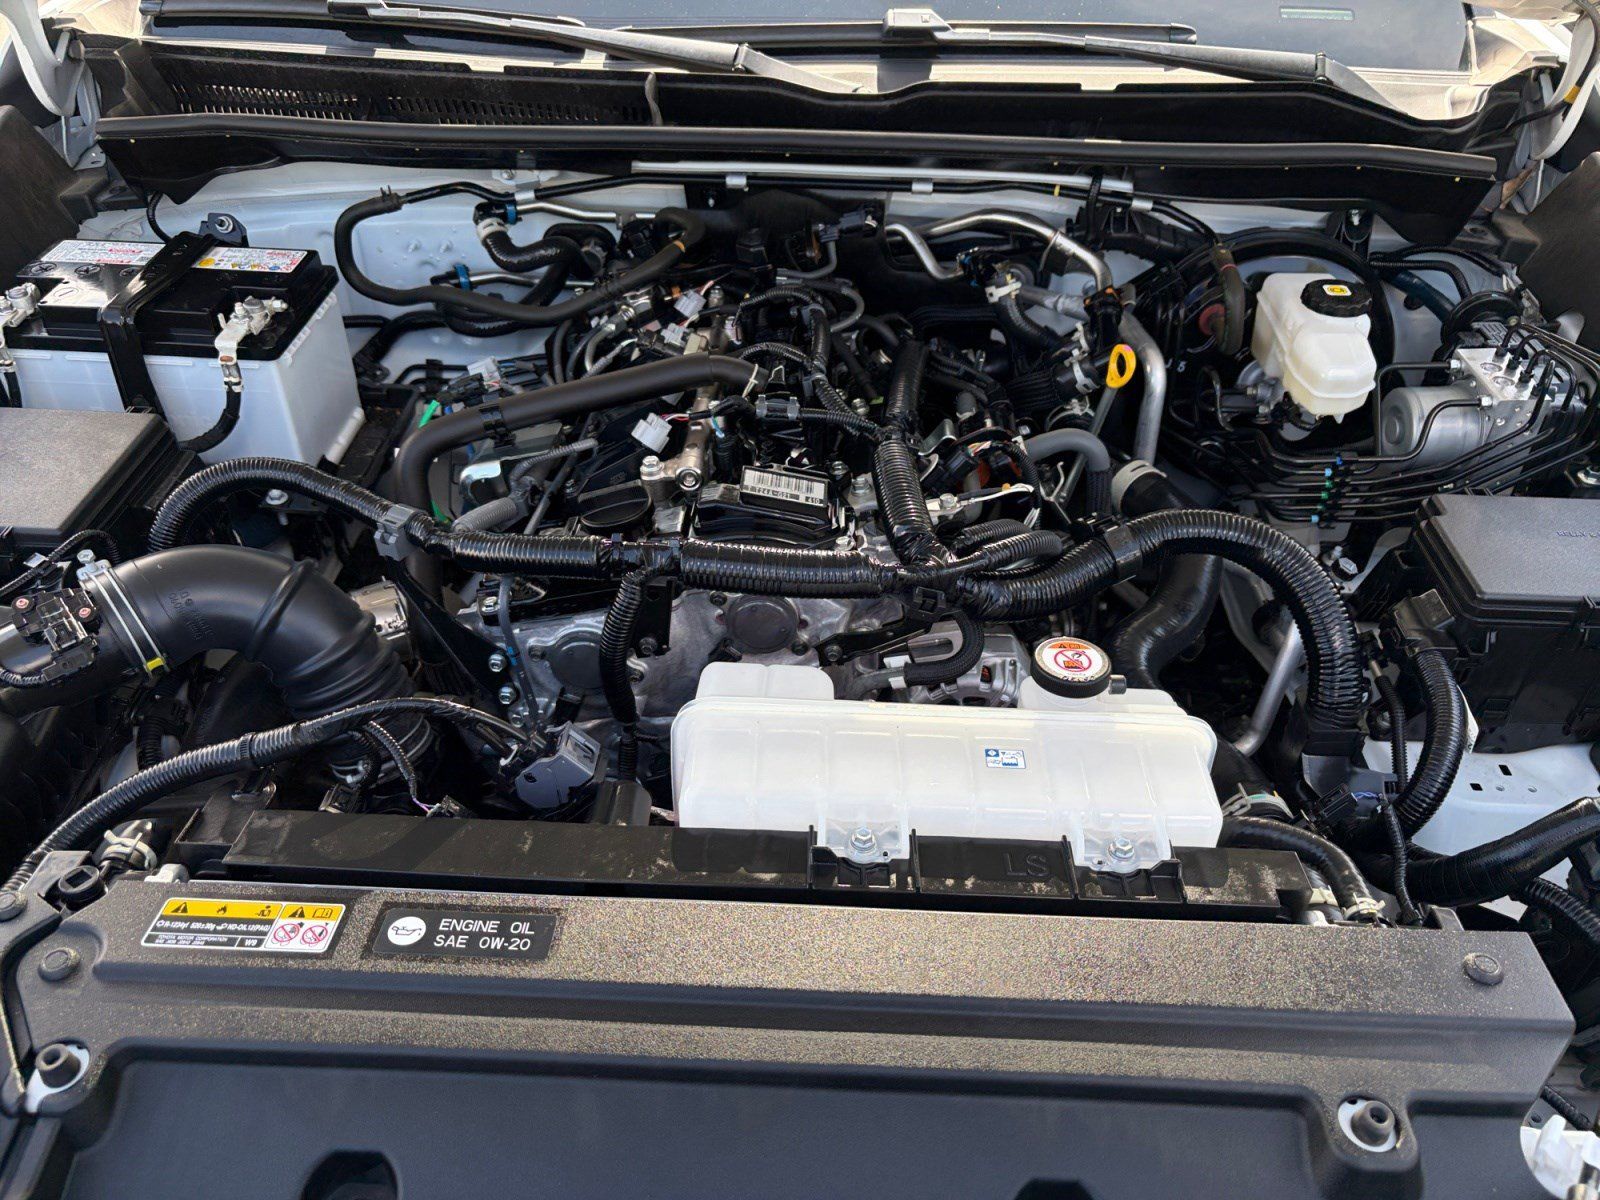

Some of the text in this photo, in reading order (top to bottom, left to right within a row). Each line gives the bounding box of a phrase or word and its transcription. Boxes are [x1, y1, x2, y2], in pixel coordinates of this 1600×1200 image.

[1003, 853, 1048, 878] LS
[439, 918, 535, 935] ENGINE OIL
[244, 938, 258, 946] W9
[433, 934, 532, 951] SAE 0W-20
